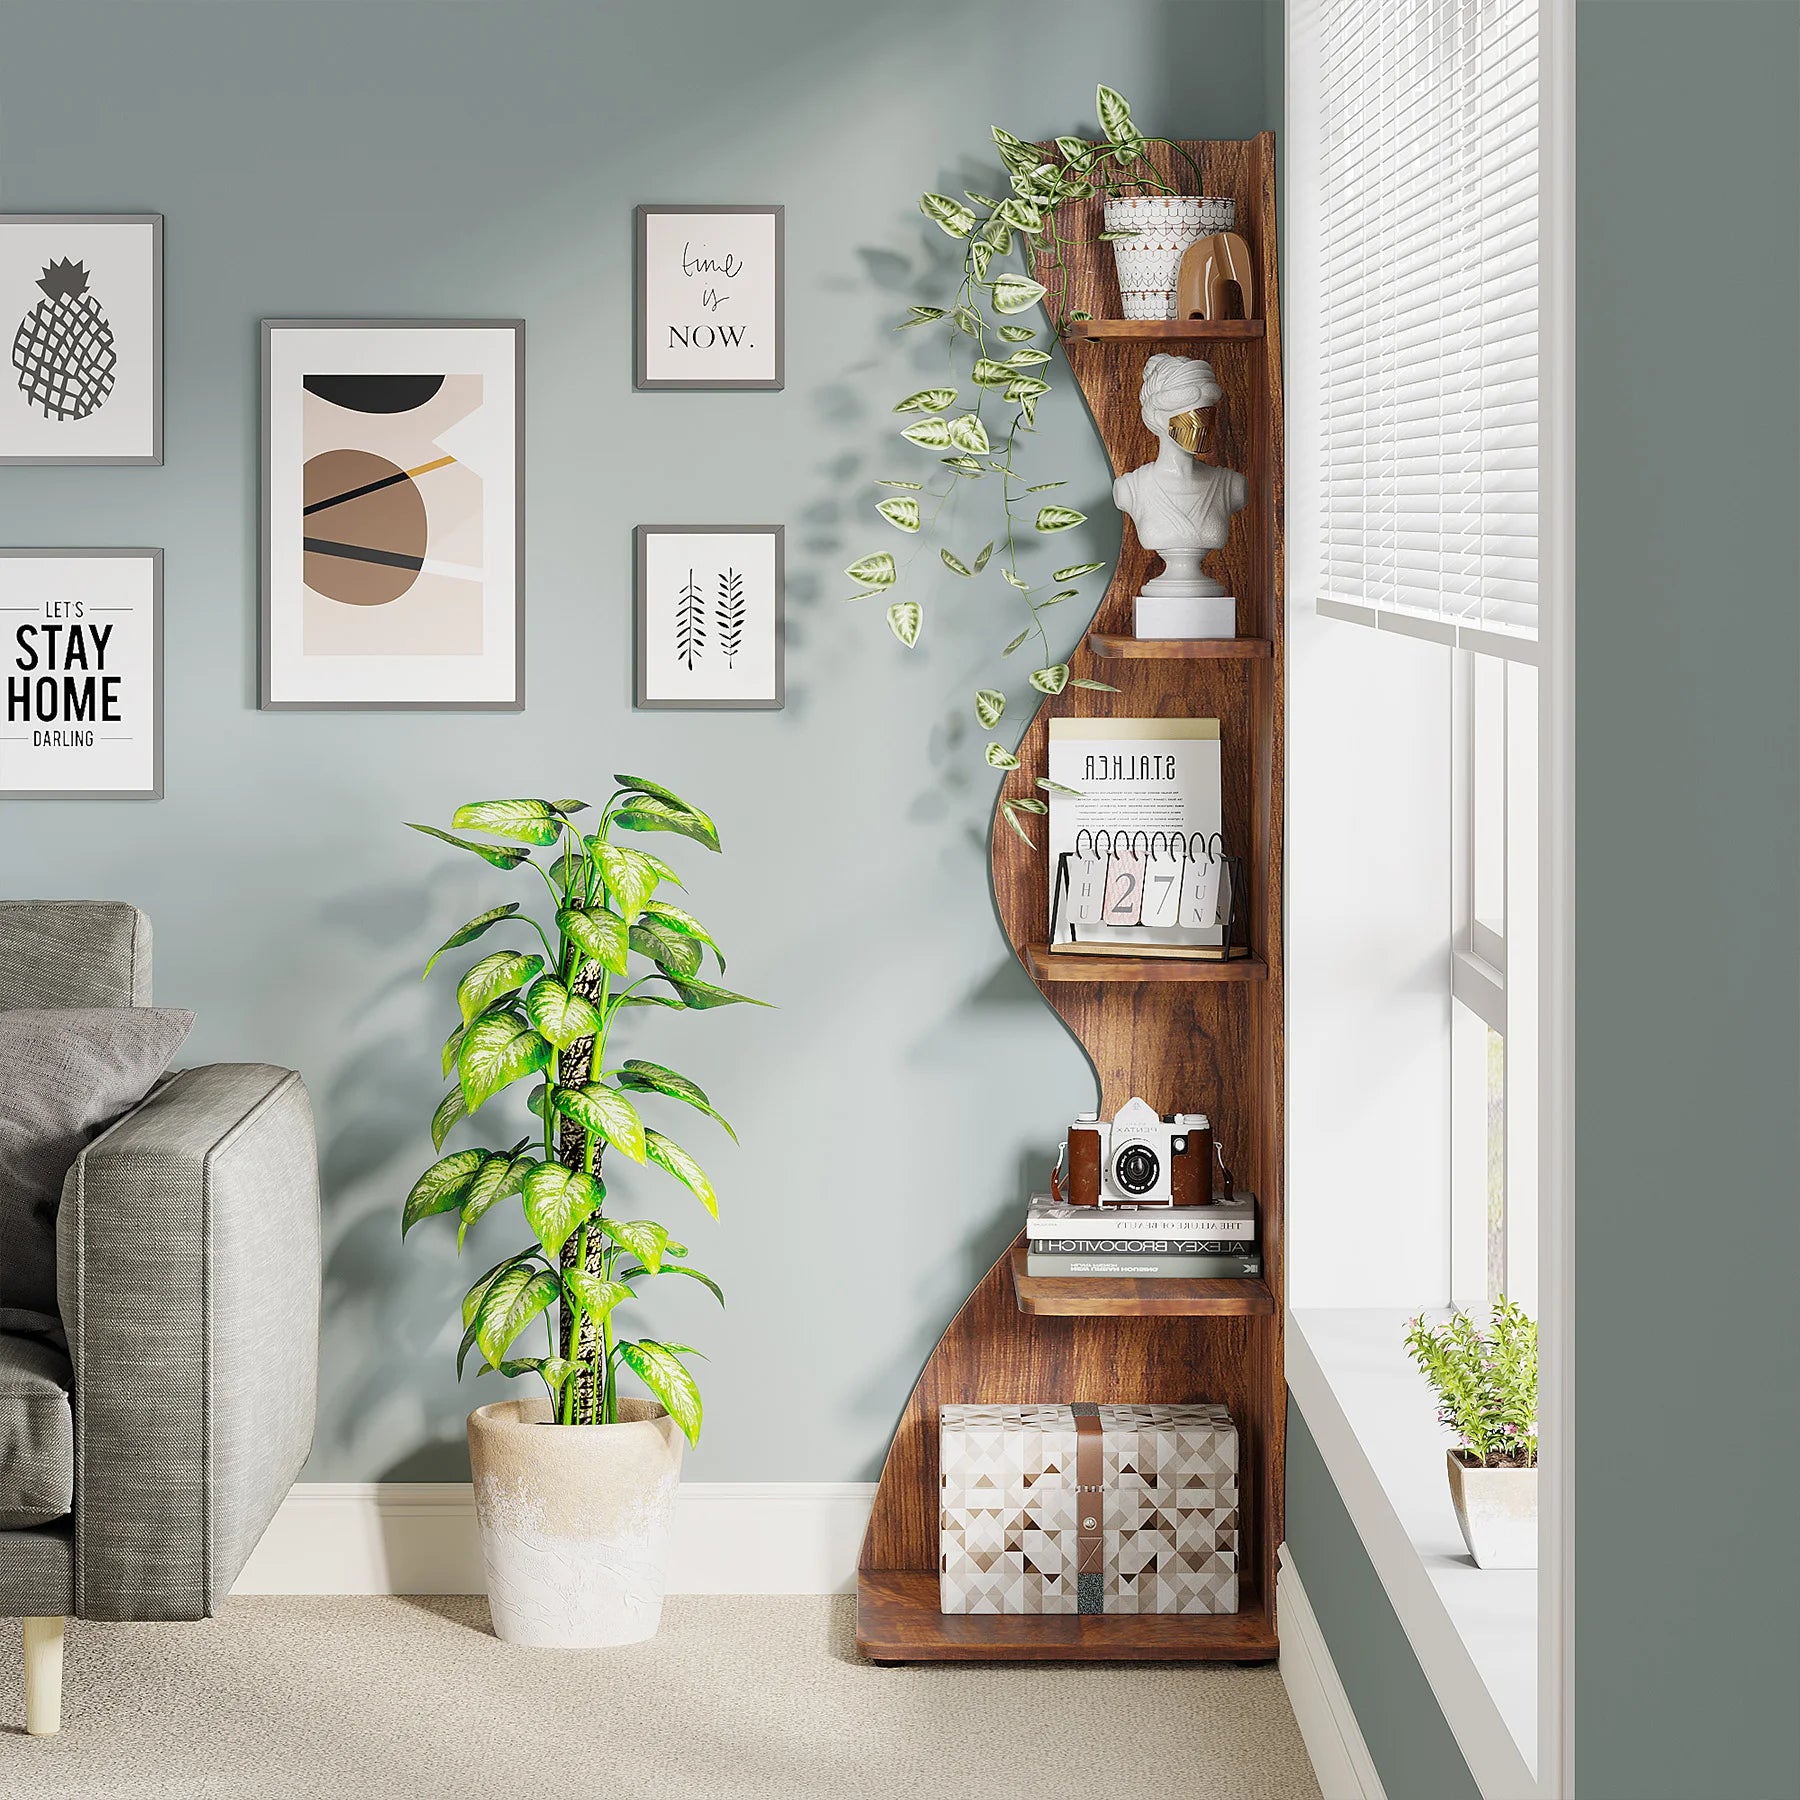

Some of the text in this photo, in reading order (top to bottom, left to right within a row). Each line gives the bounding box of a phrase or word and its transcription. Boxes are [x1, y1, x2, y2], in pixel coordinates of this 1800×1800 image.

[681, 241, 743, 278] time
[702, 281, 730, 312] is
[667, 324, 754, 349] NOW.
[45, 601, 84, 618] LET'S
[16, 624, 114, 671] STAY
[8, 676, 121, 722] HOME
[33, 730, 94, 747] DARLING
[1079, 860, 1094, 919] THU
[1191, 862, 1209, 923] JUN
